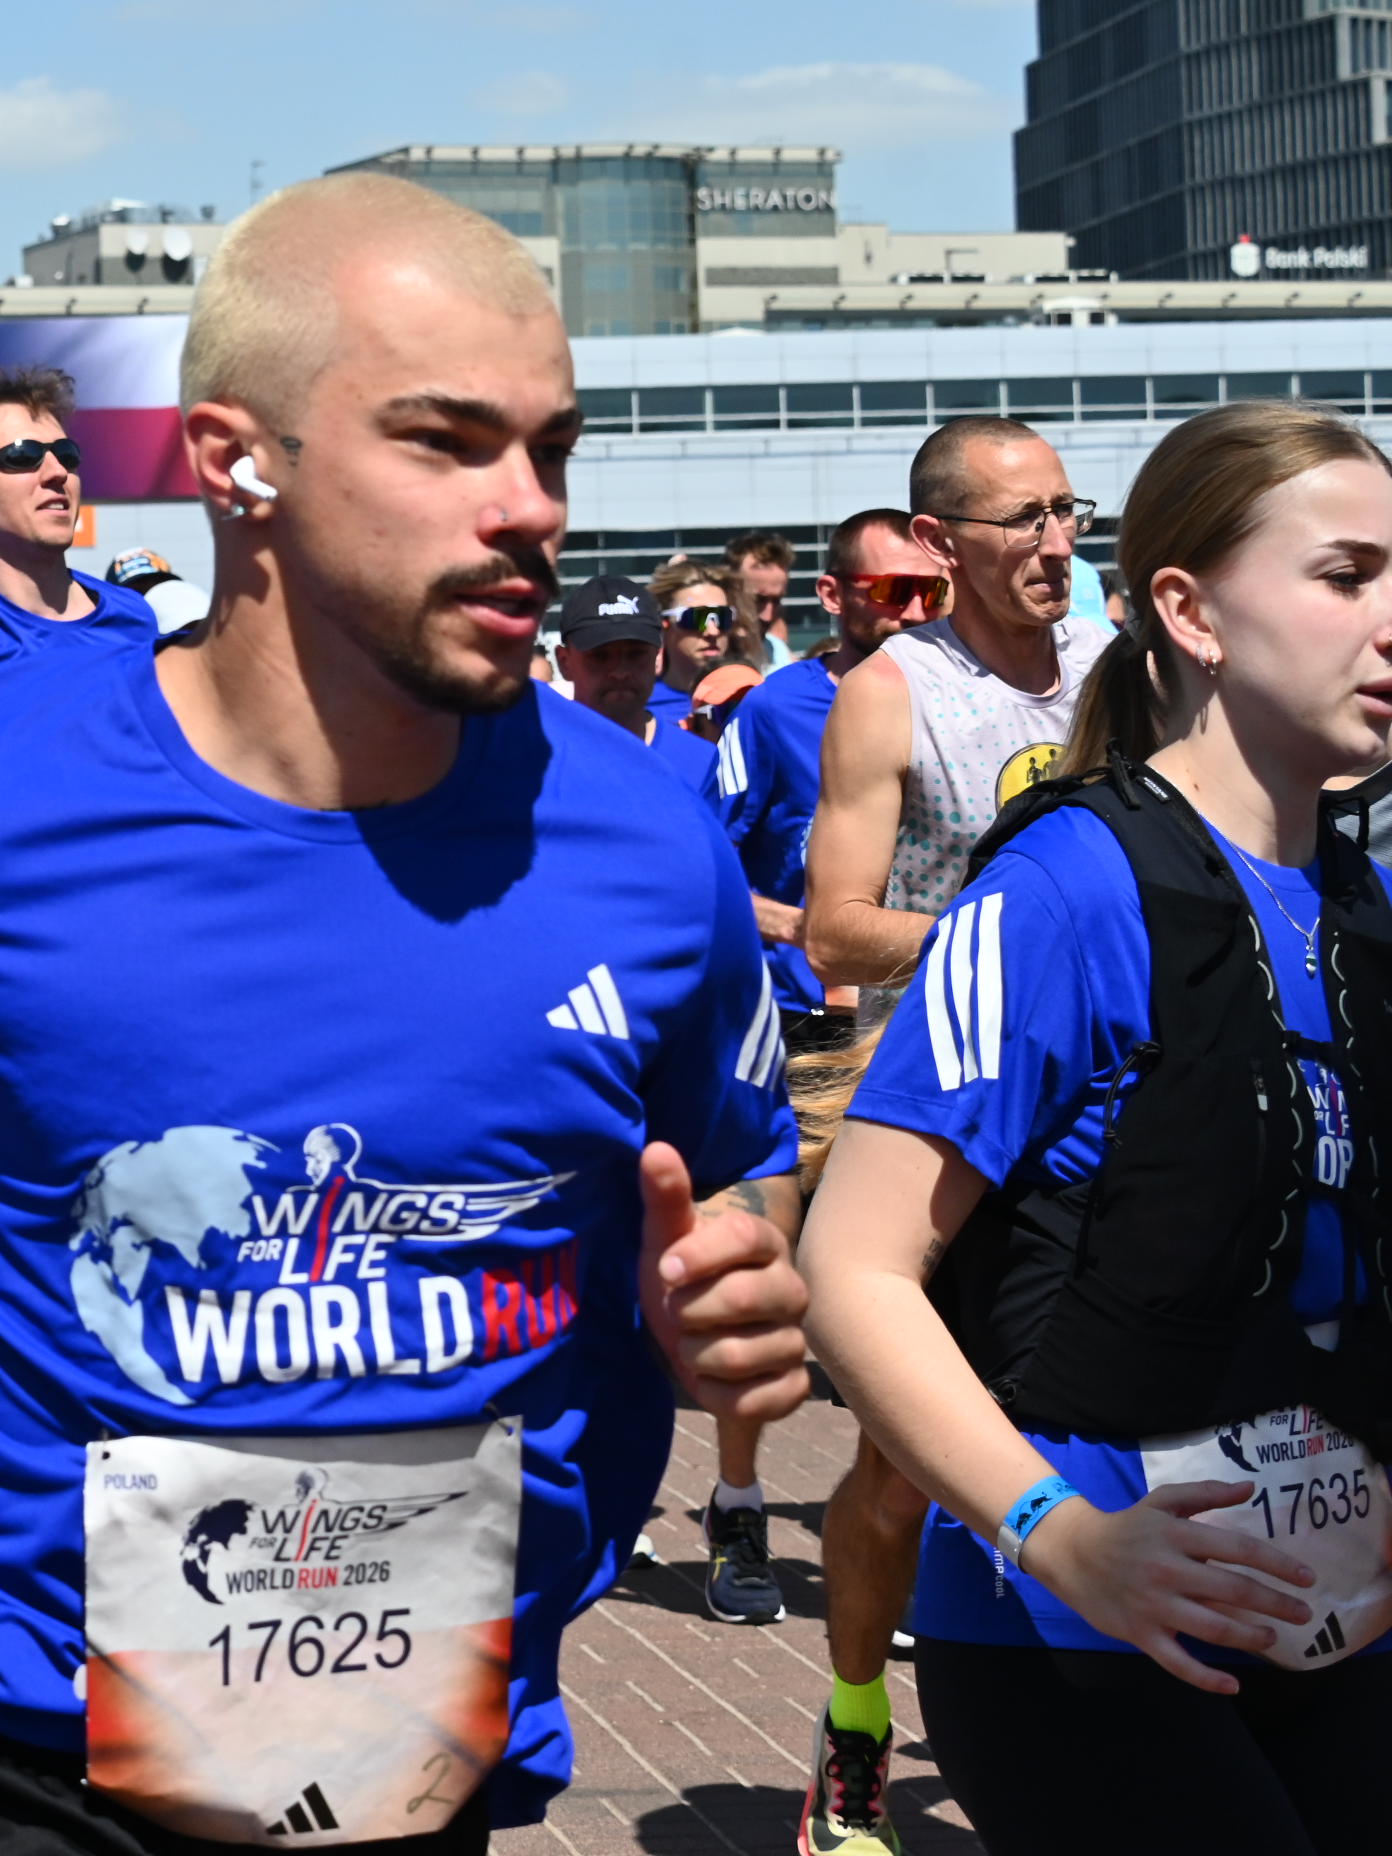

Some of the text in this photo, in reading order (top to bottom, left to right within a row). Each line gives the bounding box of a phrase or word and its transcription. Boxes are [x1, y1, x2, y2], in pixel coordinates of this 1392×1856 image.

[696, 186, 838, 211] SHERATON
[1265, 245, 1368, 269] Bank Polski
[251, 1191, 465, 1236] WINGS
[238, 1235, 397, 1285] FOR LIFE
[165, 1275, 474, 1384] WORLD
[1269, 1414, 1288, 1426] FOR
[1256, 1439, 1306, 1464] WORLD
[1306, 1434, 1326, 1456] RUN
[104, 1474, 158, 1491] POLAND
[260, 1502, 387, 1534] WINGS
[1251, 1468, 1371, 1539] 17635
[249, 1534, 349, 1562] FOR LIFE
[225, 1562, 391, 1595] WORLD RUN 2026
[208, 1607, 412, 1687] 17625
[406, 1752, 454, 1814] 2
